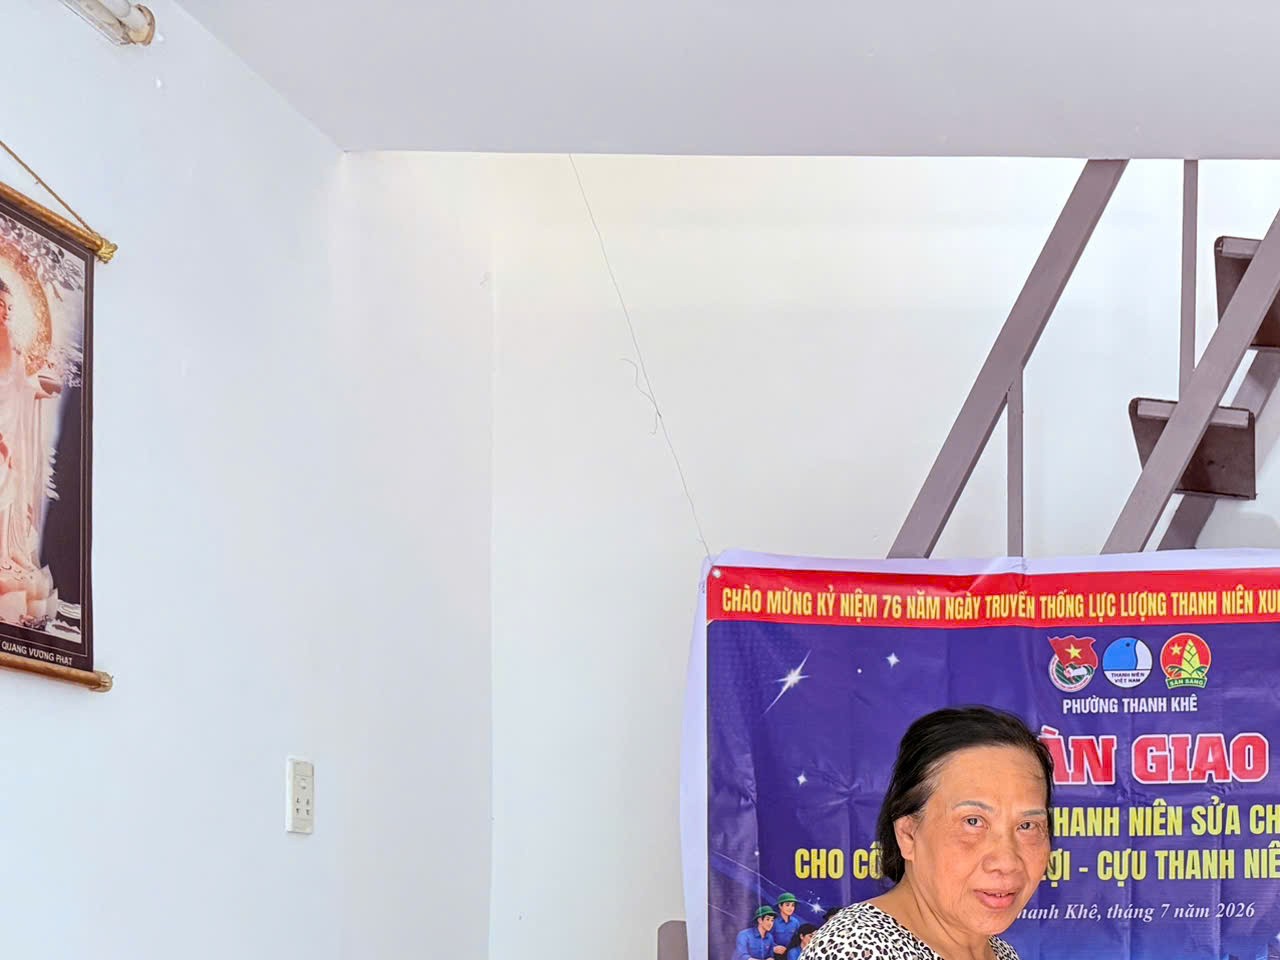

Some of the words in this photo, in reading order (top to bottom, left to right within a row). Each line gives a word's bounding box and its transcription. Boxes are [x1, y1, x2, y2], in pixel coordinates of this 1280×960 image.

[723, 585, 761, 612] CHÀO
[767, 587, 812, 615] MỪNG
[818, 585, 835, 616] KỶ
[841, 589, 877, 622] NIỆM
[883, 595, 901, 618] 76
[907, 590, 940, 619] NĂM
[945, 592, 980, 619] NGÀY
[985, 592, 1035, 618] TRUYỀN
[1040, 590, 1084, 618] THỐNG
[1089, 592, 1116, 622] LỰC
[1121, 592, 1166, 621] LƯỢNG
[1171, 592, 1216, 615] THANH
[1222, 585, 1253, 614] NIÊN
[1, 641, 27, 654] QUANG
[1063, 695, 1118, 713] PHƯỜNG
[1122, 698, 1166, 712] THANH
[1172, 694, 1197, 711] KHÊ
[1037, 725, 1117, 784] ÀN
[1132, 733, 1269, 784] GIAO
[1051, 807, 1119, 836] HANH
[1129, 798, 1182, 836] NIÊN
[1192, 796, 1240, 835] SỬA
[795, 849, 843, 878] CHO
[1042, 848, 1070, 887] ỢI
[1098, 849, 1146, 887] CỰU
[1155, 850, 1234, 879] THANH
[1065, 904, 1100, 920] Khê,
[1107, 904, 1154, 922] tháng
[1162, 904, 1170, 917] 7
[1174, 904, 1209, 917] năm
[1216, 903, 1254, 917] 2026
